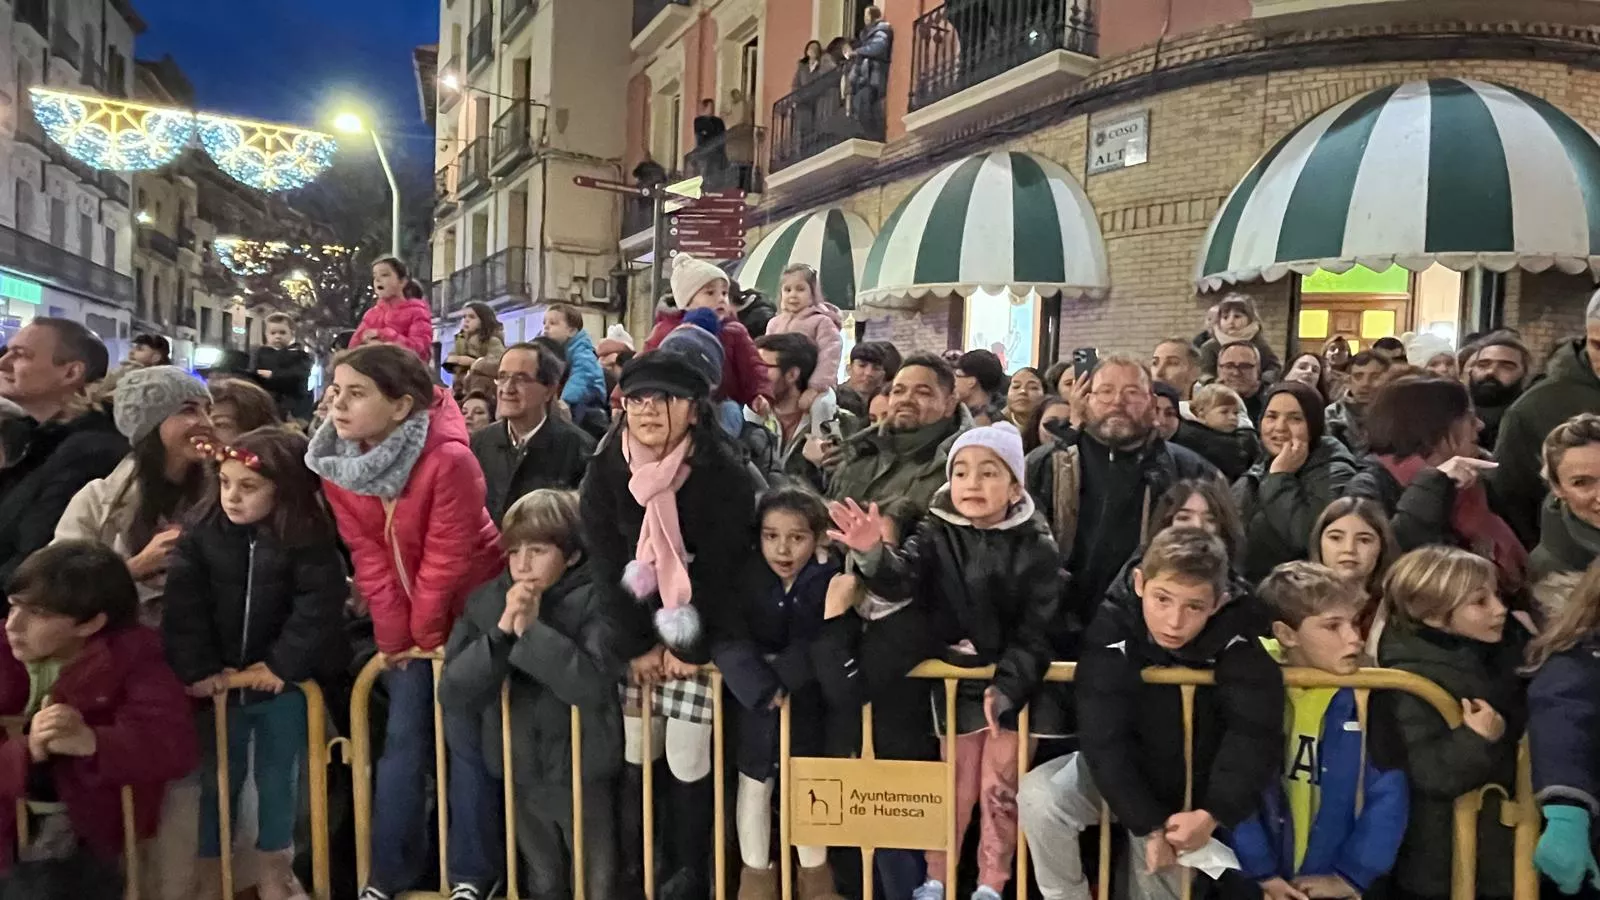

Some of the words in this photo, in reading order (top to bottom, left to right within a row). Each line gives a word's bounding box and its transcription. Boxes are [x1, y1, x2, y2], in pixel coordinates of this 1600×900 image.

[1108, 123, 1138, 139] COSO
[1095, 145, 1133, 166] ALT
[850, 789, 943, 804] Ayuntamiento
[850, 804, 866, 816] de
[873, 804, 925, 817] Huesca
